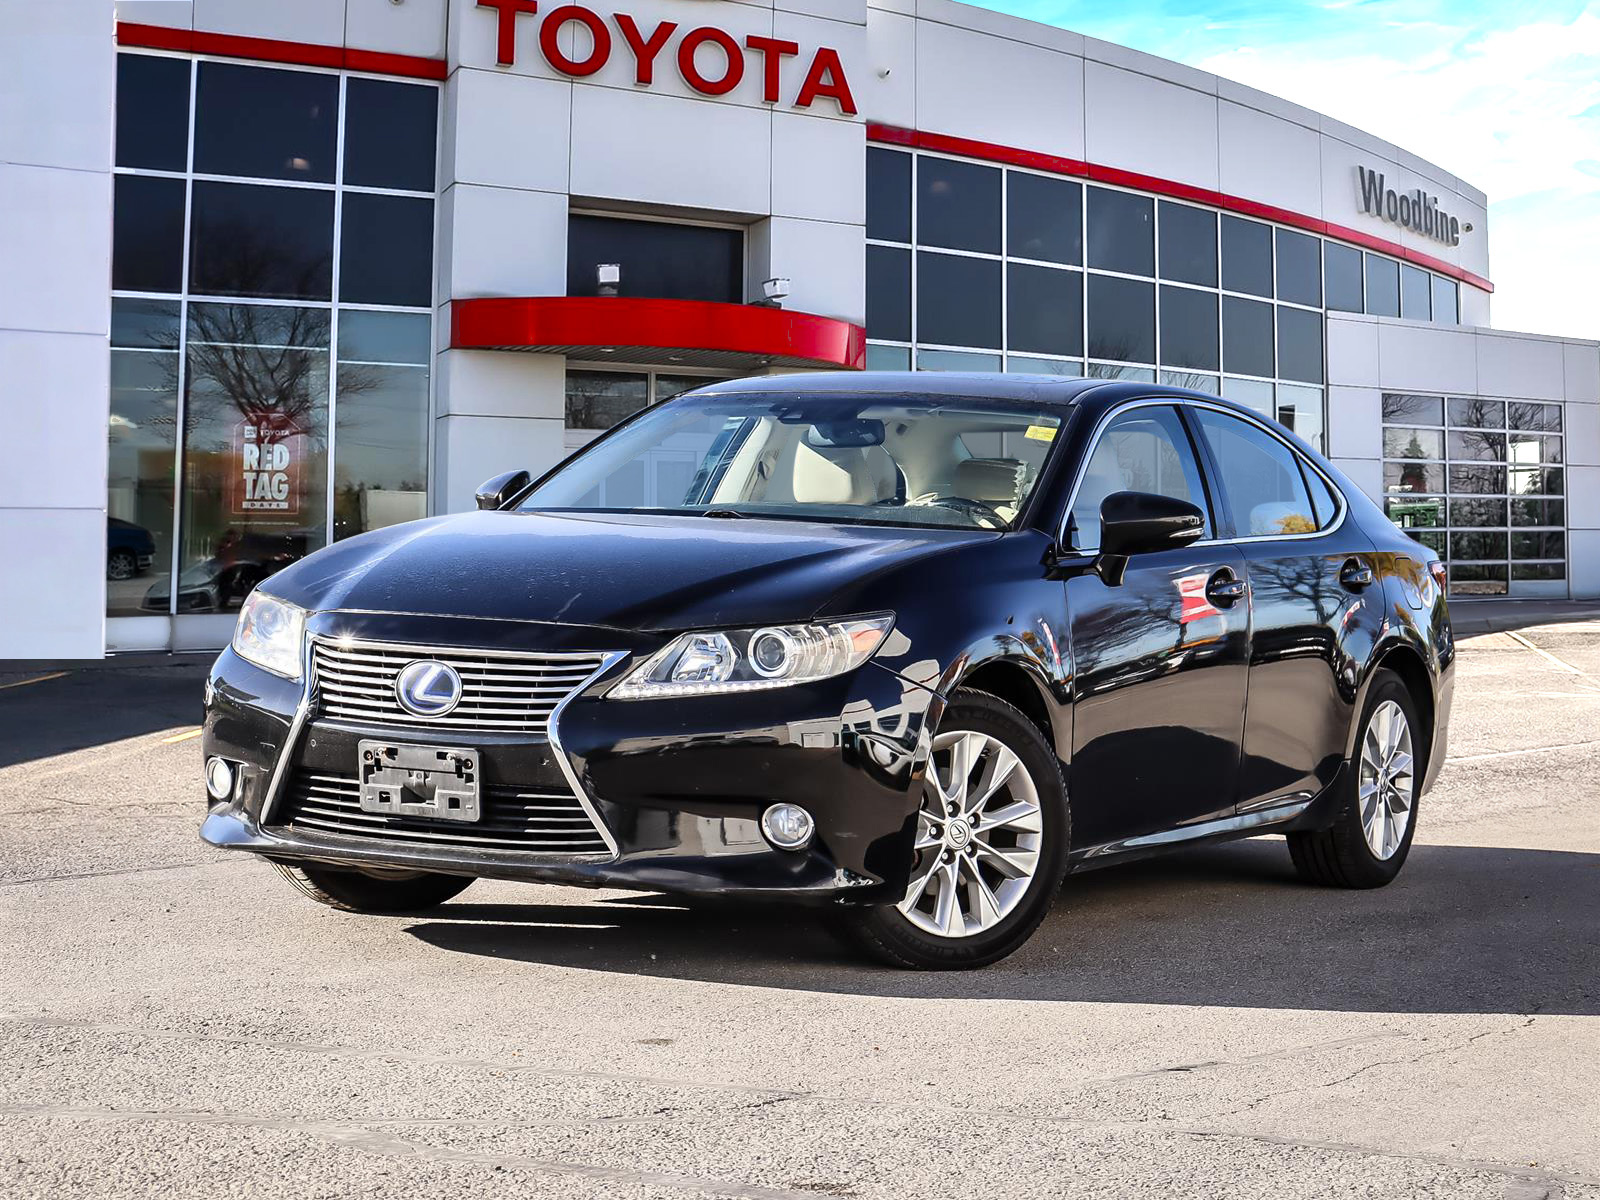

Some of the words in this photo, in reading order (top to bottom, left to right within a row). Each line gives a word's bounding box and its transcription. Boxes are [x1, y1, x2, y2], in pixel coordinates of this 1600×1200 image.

[476, 0, 858, 116] TOYOTA
[1356, 165, 1460, 247] Woodbine
[260, 429, 290, 437] TOYOTA
[243, 443, 290, 471] RED
[243, 472, 289, 500] TAG
